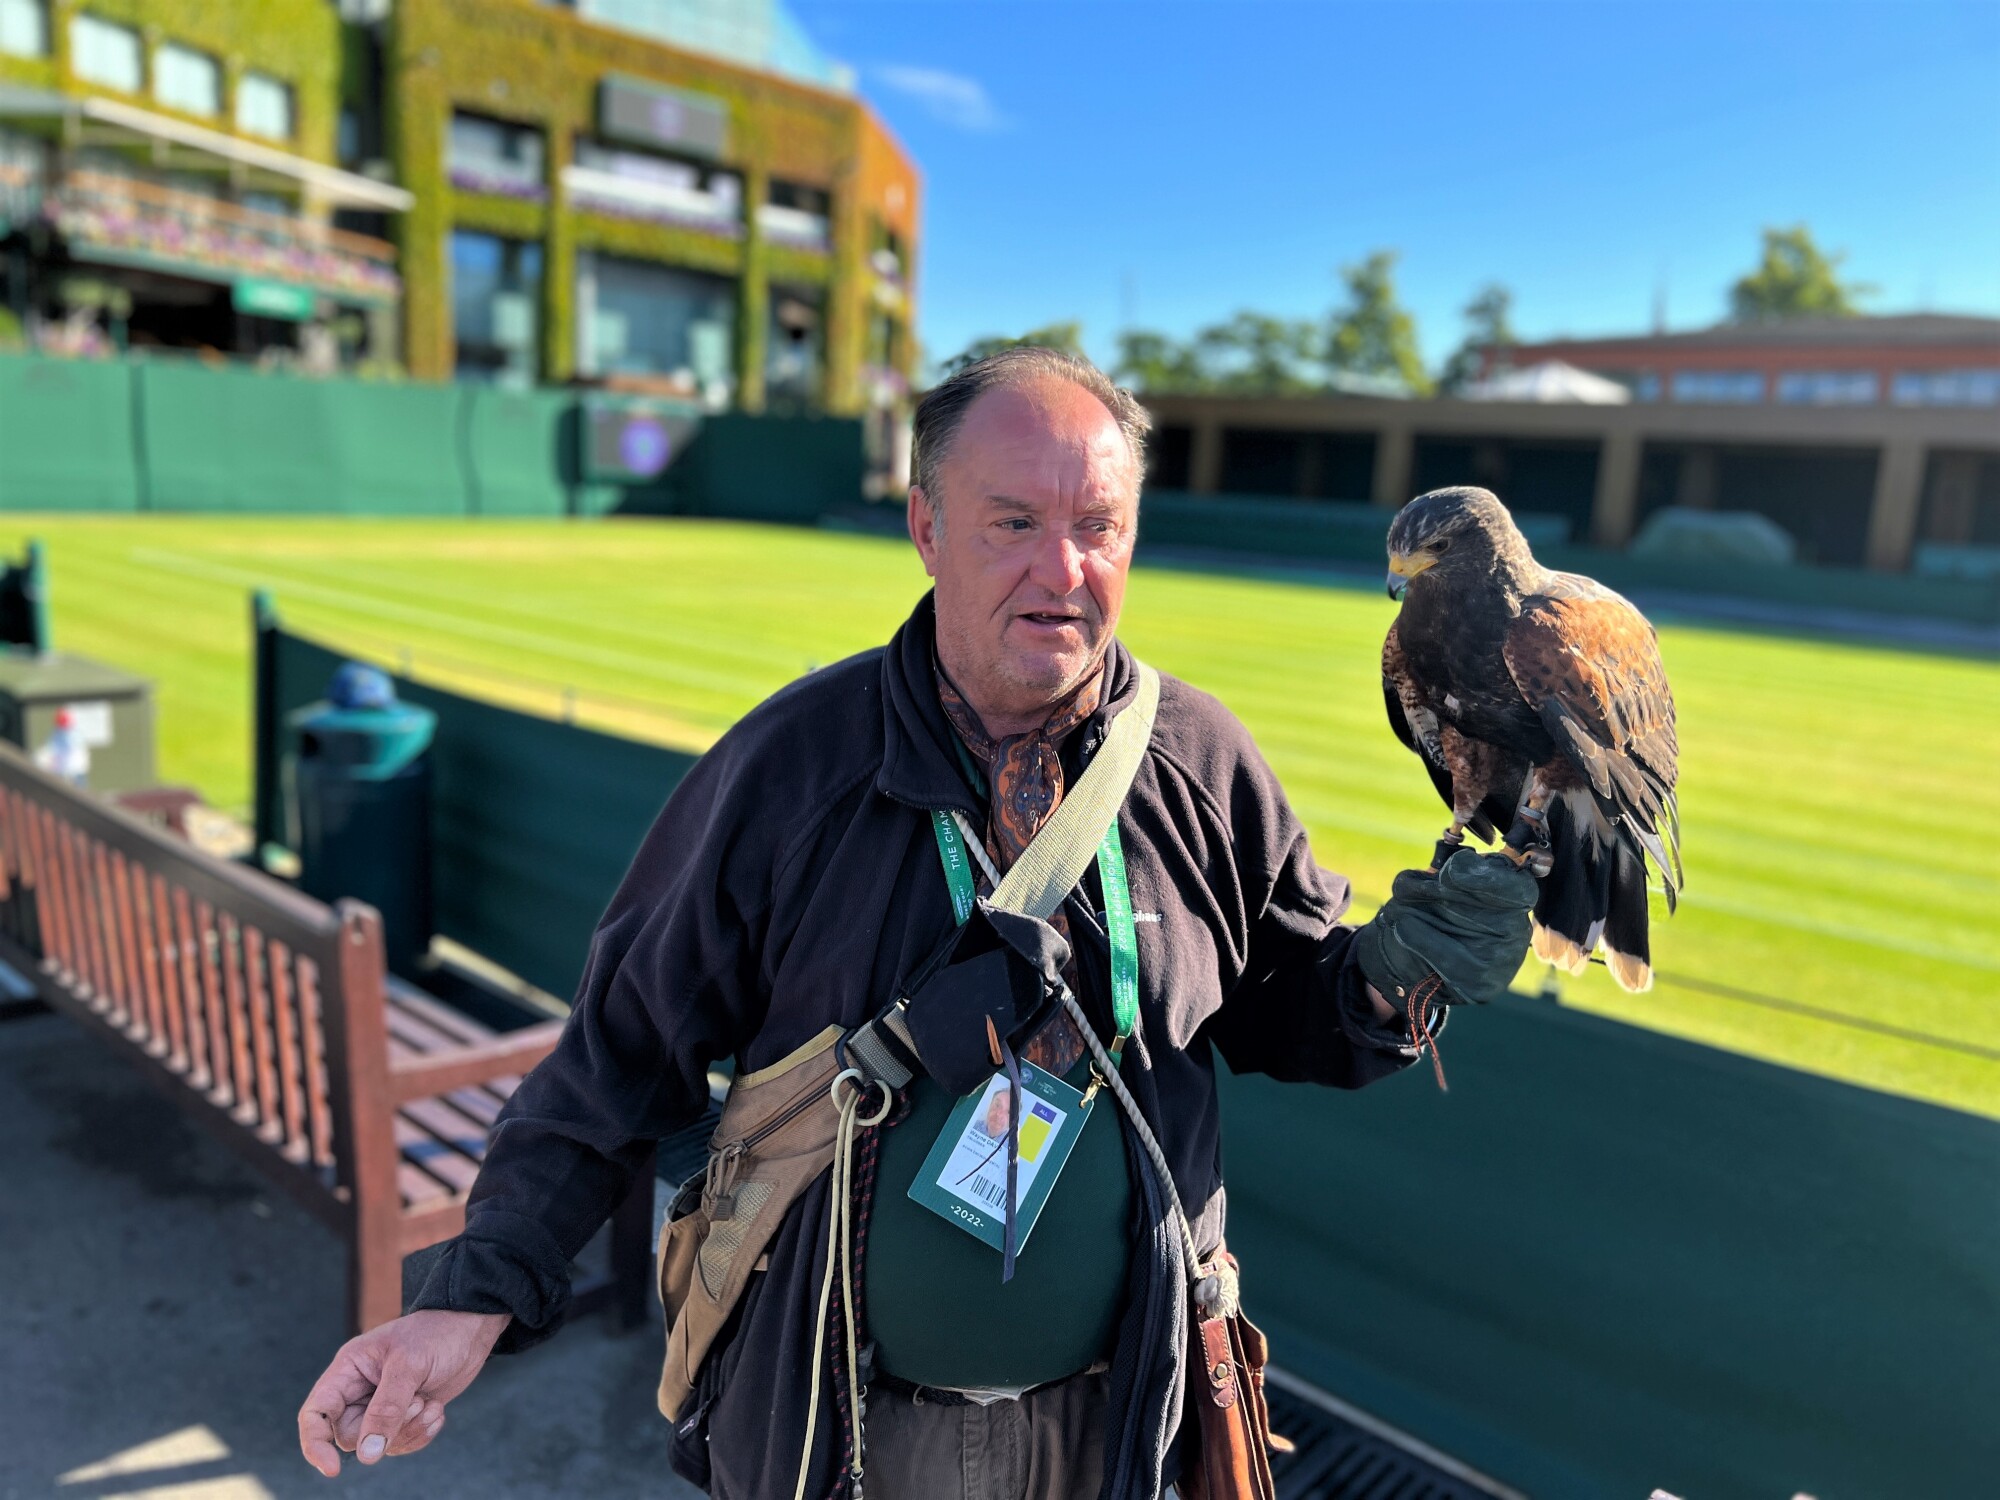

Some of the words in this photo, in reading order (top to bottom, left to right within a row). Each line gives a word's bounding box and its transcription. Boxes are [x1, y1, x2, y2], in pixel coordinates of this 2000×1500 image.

[948, 846, 961, 870] THE
[1102, 838, 1125, 917] AMPIONSHIPS
[1116, 921, 1128, 951] 2022
[1039, 1108, 1048, 1118] ALL
[986, 1139, 1003, 1152] DAVS
